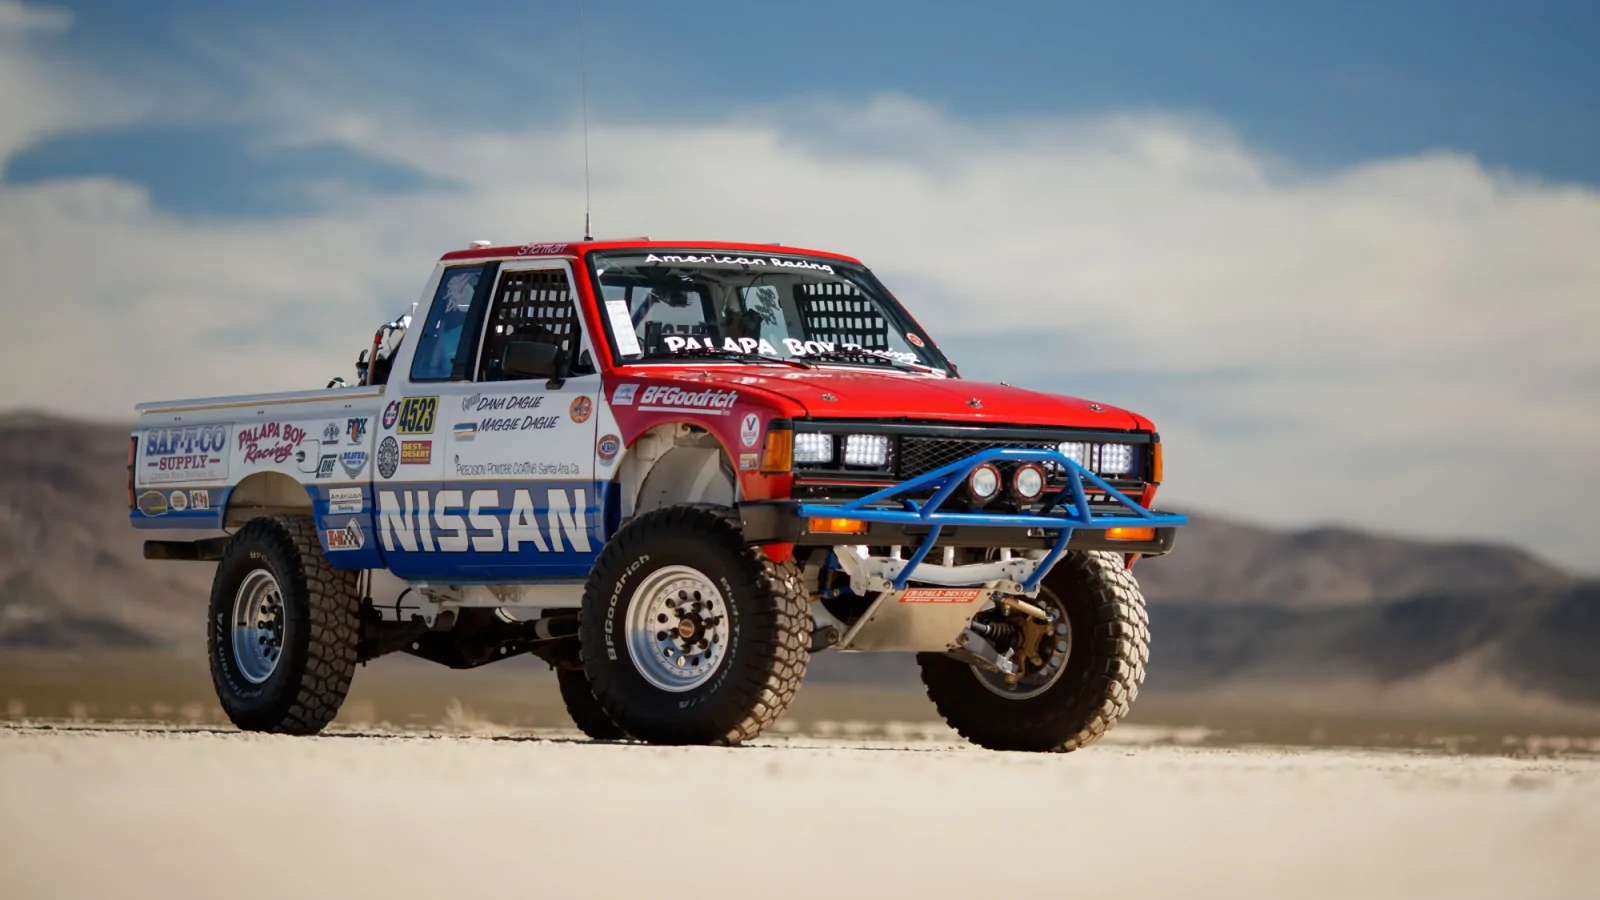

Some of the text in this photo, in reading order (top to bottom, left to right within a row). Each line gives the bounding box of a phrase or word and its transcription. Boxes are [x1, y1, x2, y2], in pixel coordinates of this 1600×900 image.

[645, 254, 835, 275] American Racing
[664, 336, 779, 355] PALAPA
[783, 338, 834, 357] BOY
[476, 397, 505, 411] DANA
[506, 396, 545, 410] DAGUE
[640, 386, 738, 408] BFGoodrich
[399, 397, 436, 432] 4523
[478, 415, 560, 432] MAGGIE DAGUE
[238, 422, 280, 451] PALAPA
[283, 424, 307, 447] BOY
[159, 455, 208, 471] SUPPLY
[244, 441, 293, 464] Racing
[402, 450, 430, 458] DESERT
[538, 462, 557, 475] Santa
[379, 488, 592, 552] NISSAN
[605, 555, 650, 660] BFGoodrich
